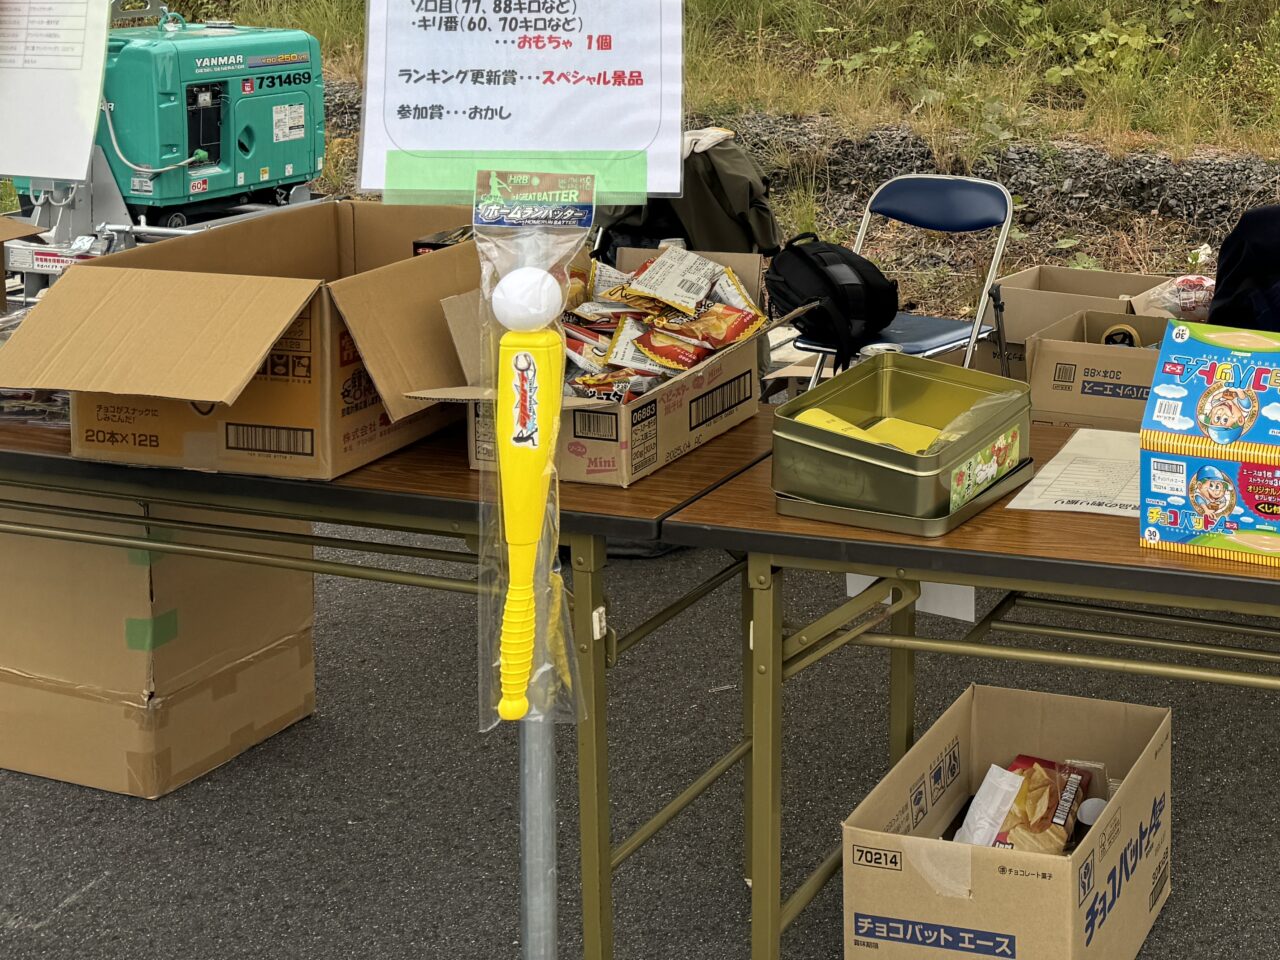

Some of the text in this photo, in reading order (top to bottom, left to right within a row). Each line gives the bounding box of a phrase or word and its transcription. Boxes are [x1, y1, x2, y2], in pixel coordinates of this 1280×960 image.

[587, 34, 612, 51] 1個
[195, 54, 243, 68] YANMAR
[256, 71, 312, 89] 731469
[537, 189, 579, 202] BATTER
[1083, 382, 1113, 395] エース
[96, 404, 159, 418] チョコがスナックに
[632, 402, 656, 424] 06883
[587, 456, 617, 469] Mini
[856, 848, 899, 868] 70214
[857, 916, 1013, 956] チョコバット エース
